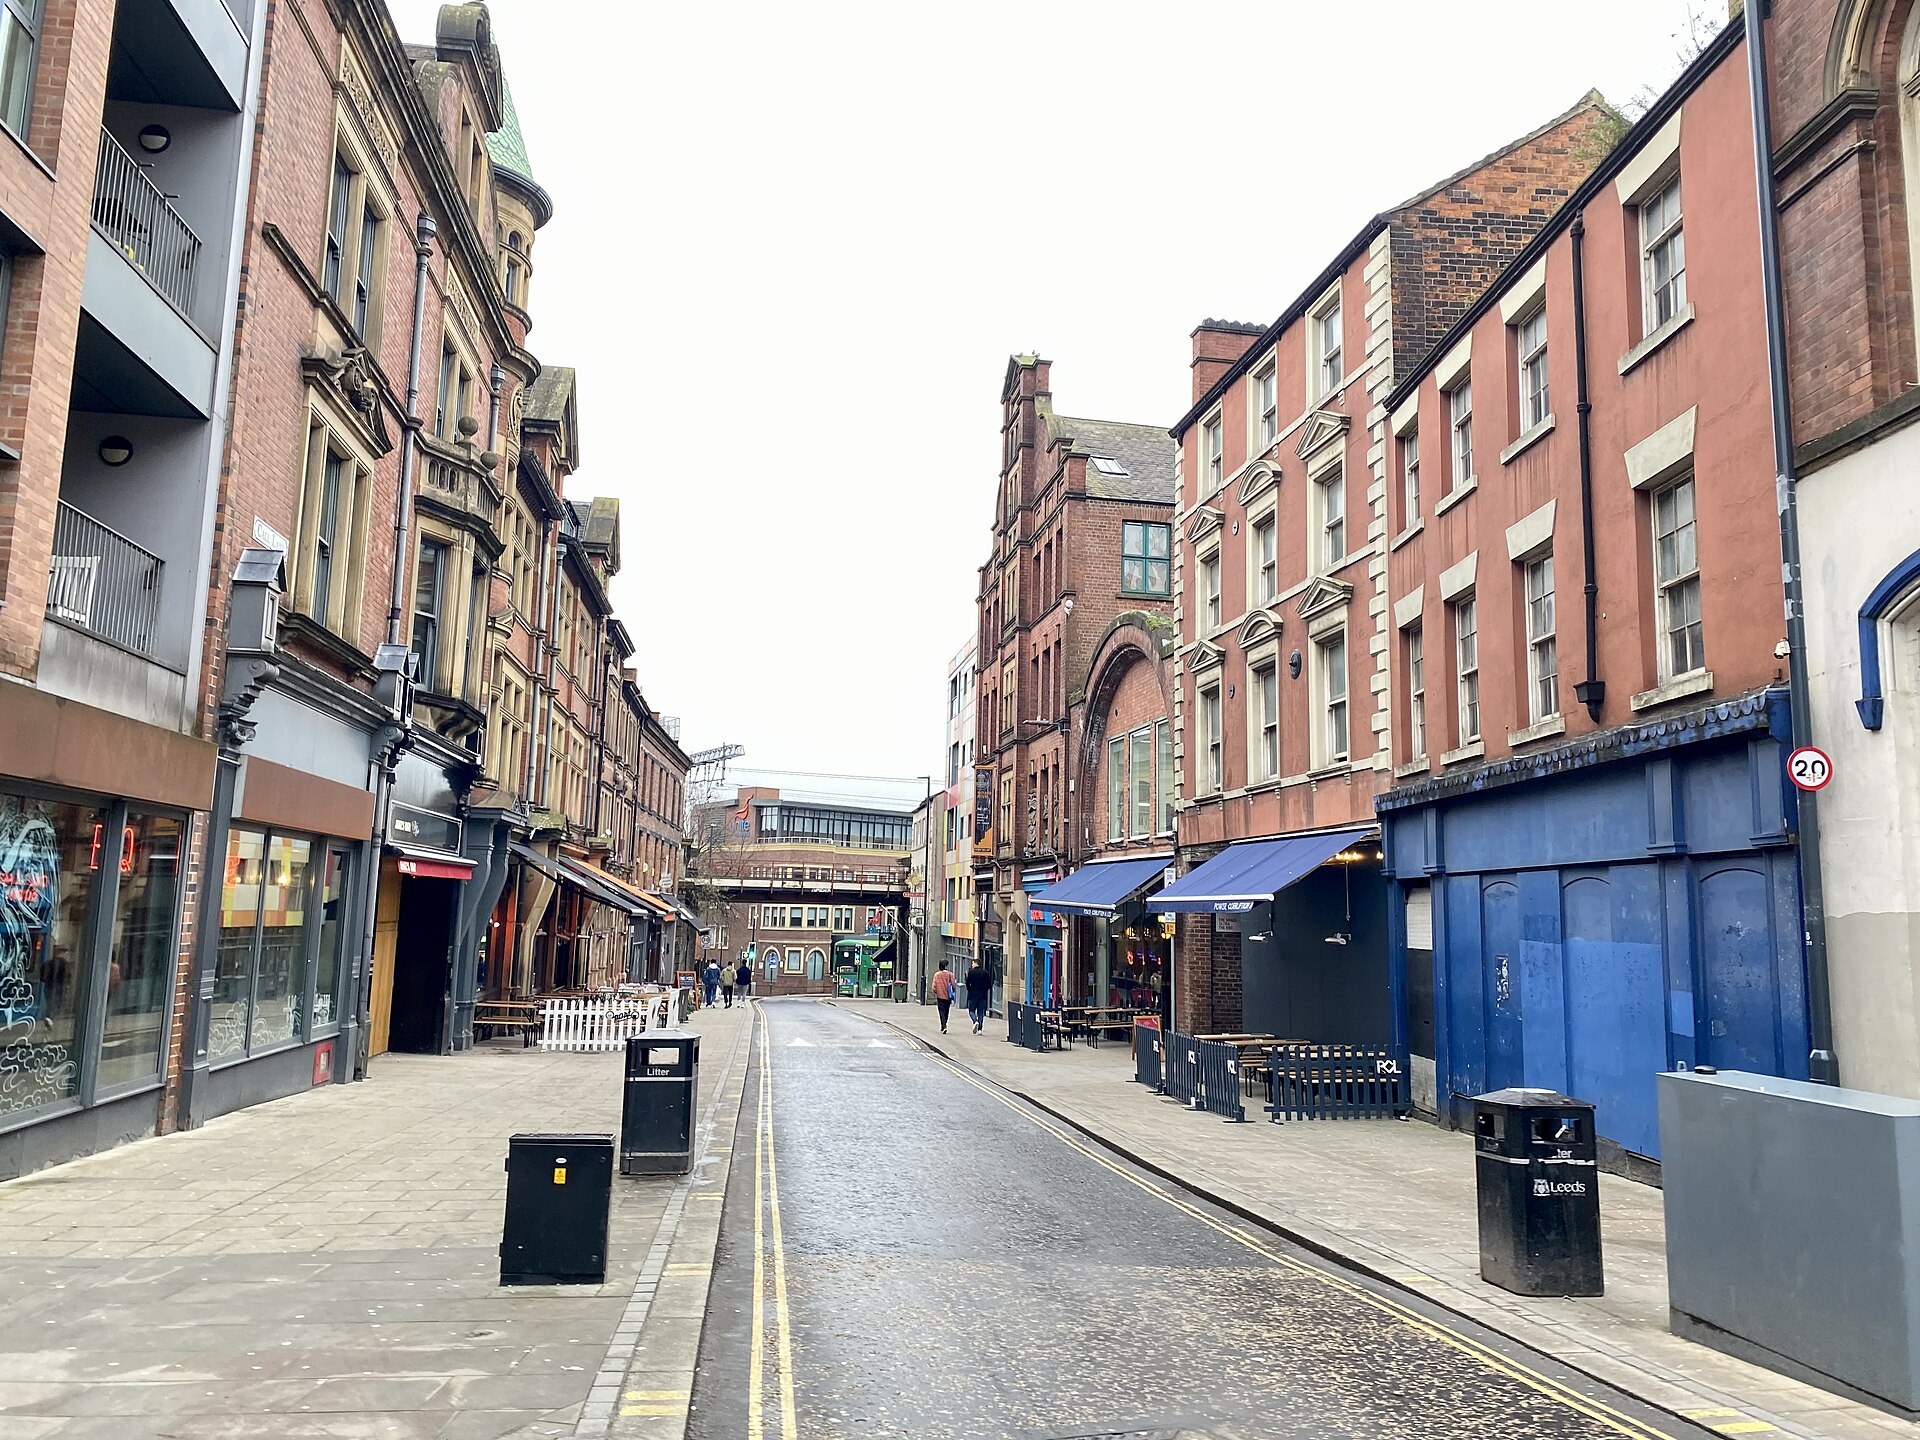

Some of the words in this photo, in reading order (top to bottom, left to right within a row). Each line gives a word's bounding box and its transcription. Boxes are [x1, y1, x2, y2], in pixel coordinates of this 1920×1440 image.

[1795, 760, 1825, 777] 20
[646, 1067, 670, 1076] Litter
[1550, 1180, 1586, 1193] Leeds
